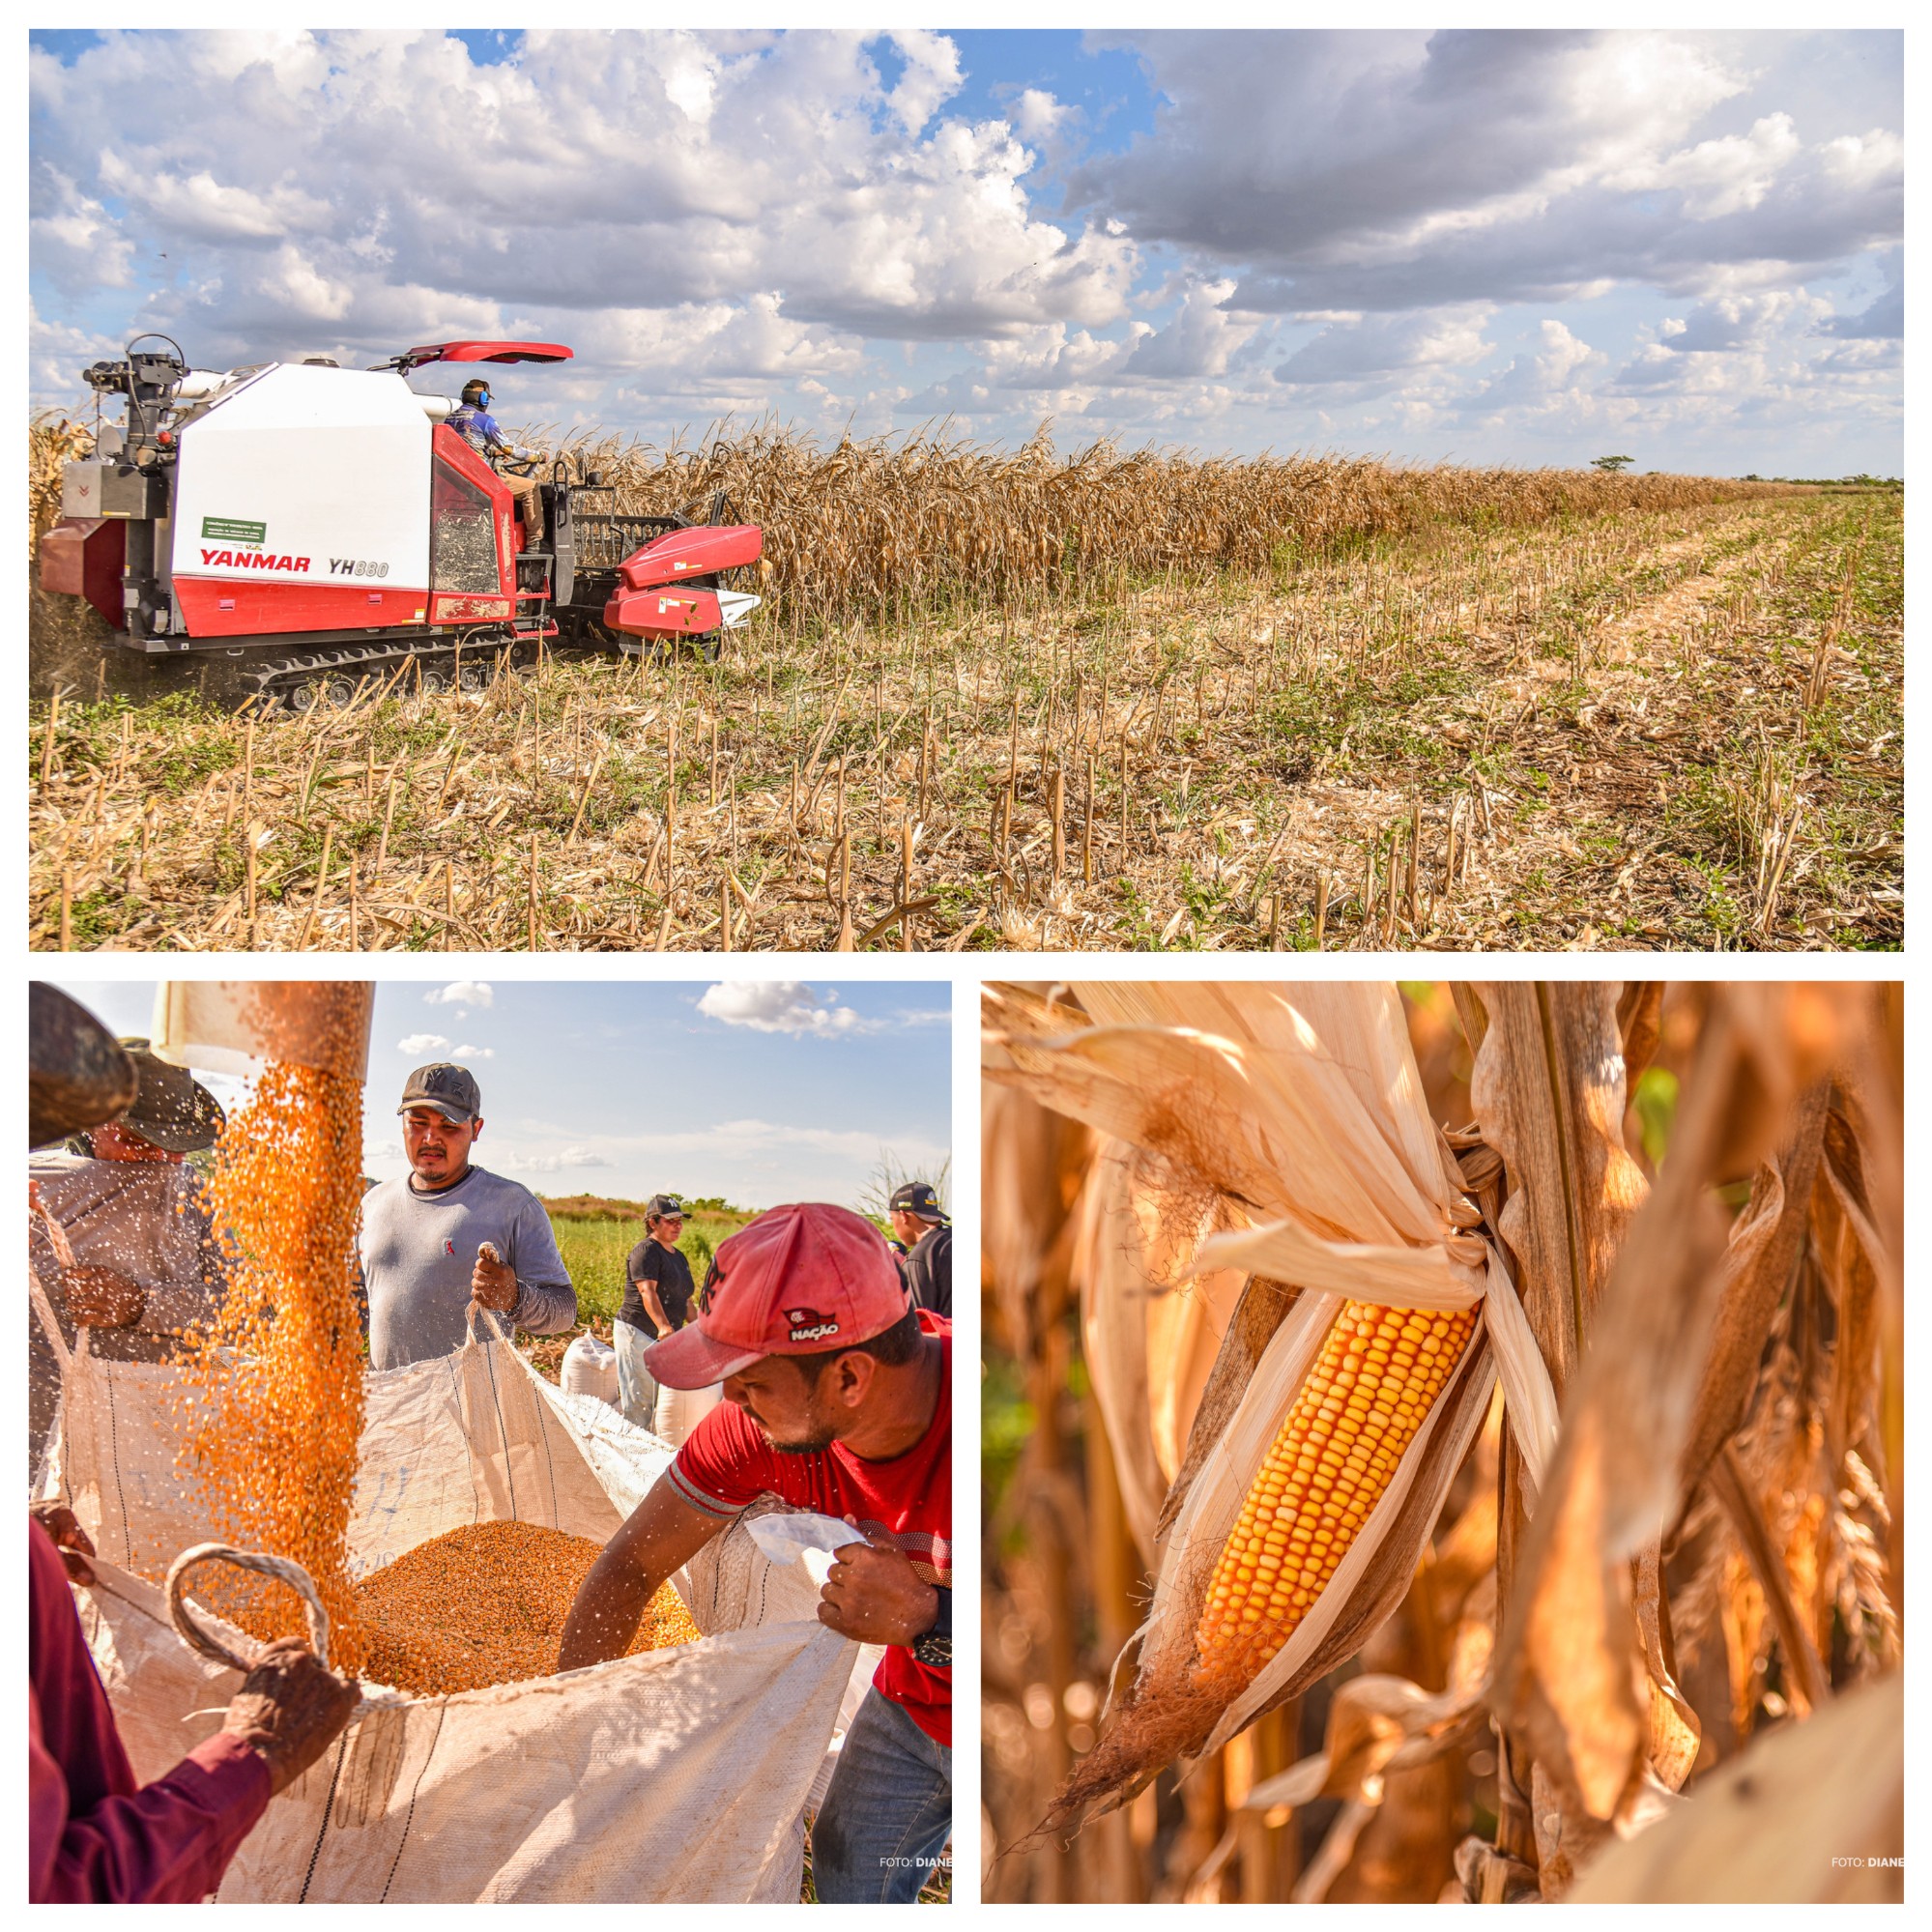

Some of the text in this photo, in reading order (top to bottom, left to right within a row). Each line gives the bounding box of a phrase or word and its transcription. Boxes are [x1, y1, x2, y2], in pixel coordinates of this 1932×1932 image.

[200, 549, 389, 578] YANMAR YH880
[791, 1323, 839, 1341] NAÇÃO
